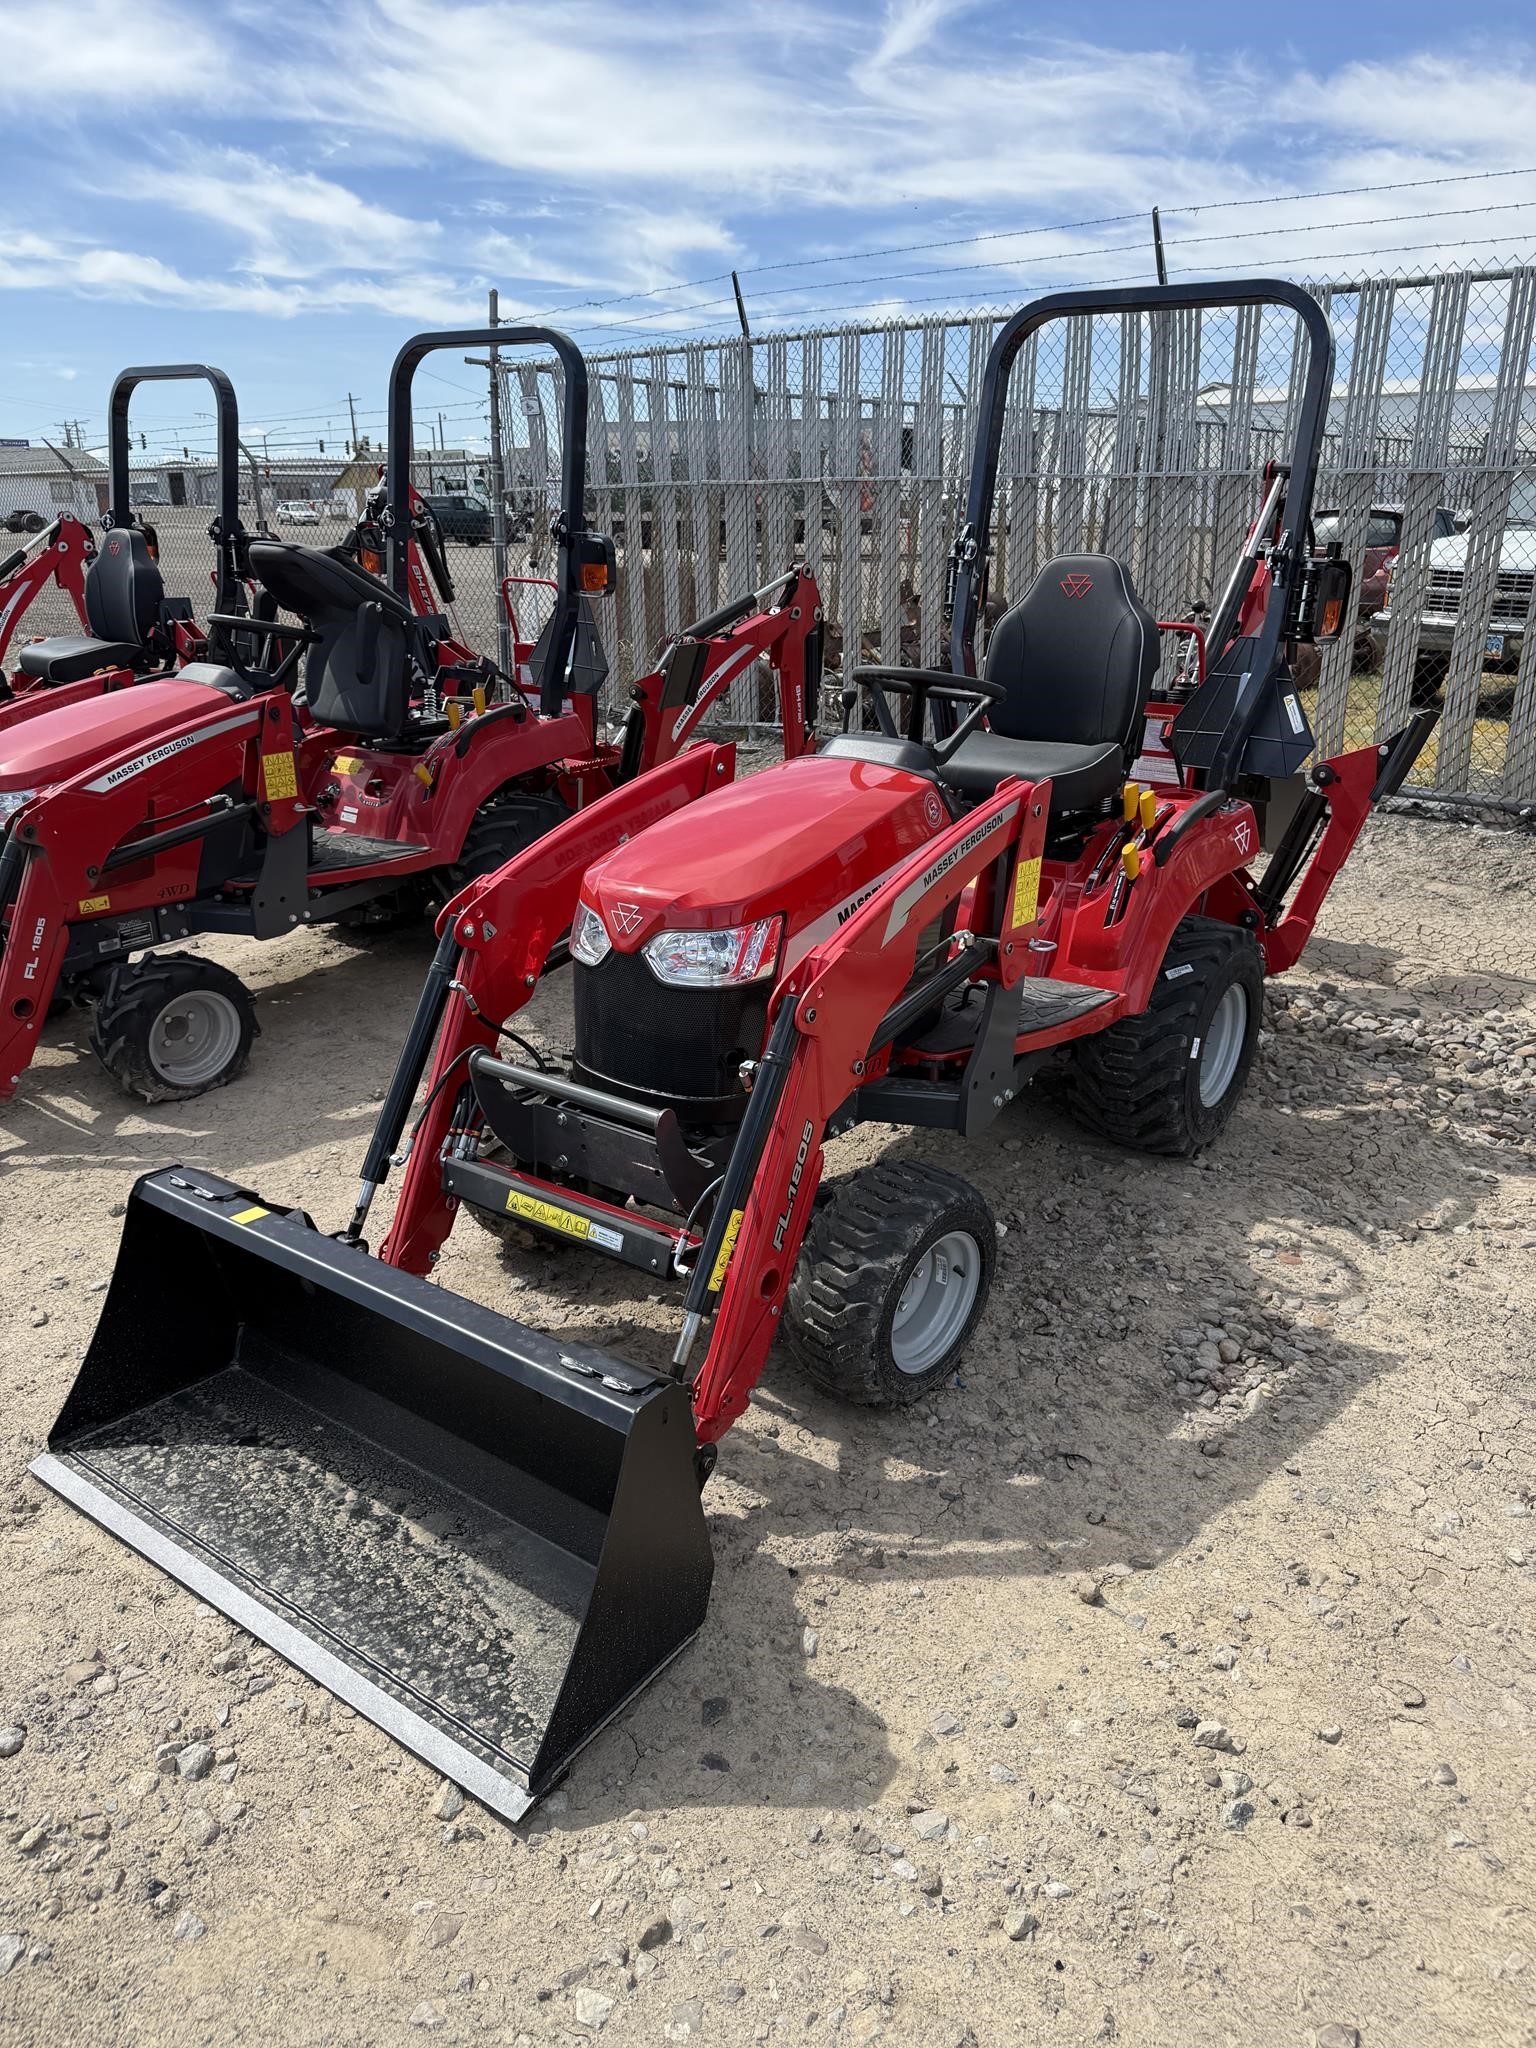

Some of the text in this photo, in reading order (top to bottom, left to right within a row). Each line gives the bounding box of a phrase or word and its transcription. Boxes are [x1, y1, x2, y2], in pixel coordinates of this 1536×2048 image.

[107, 735, 195, 784] MASSEY FERGUSON
[923, 813, 1004, 888] MASSEY FERGUSON
[24, 917, 46, 979] FL 1805
